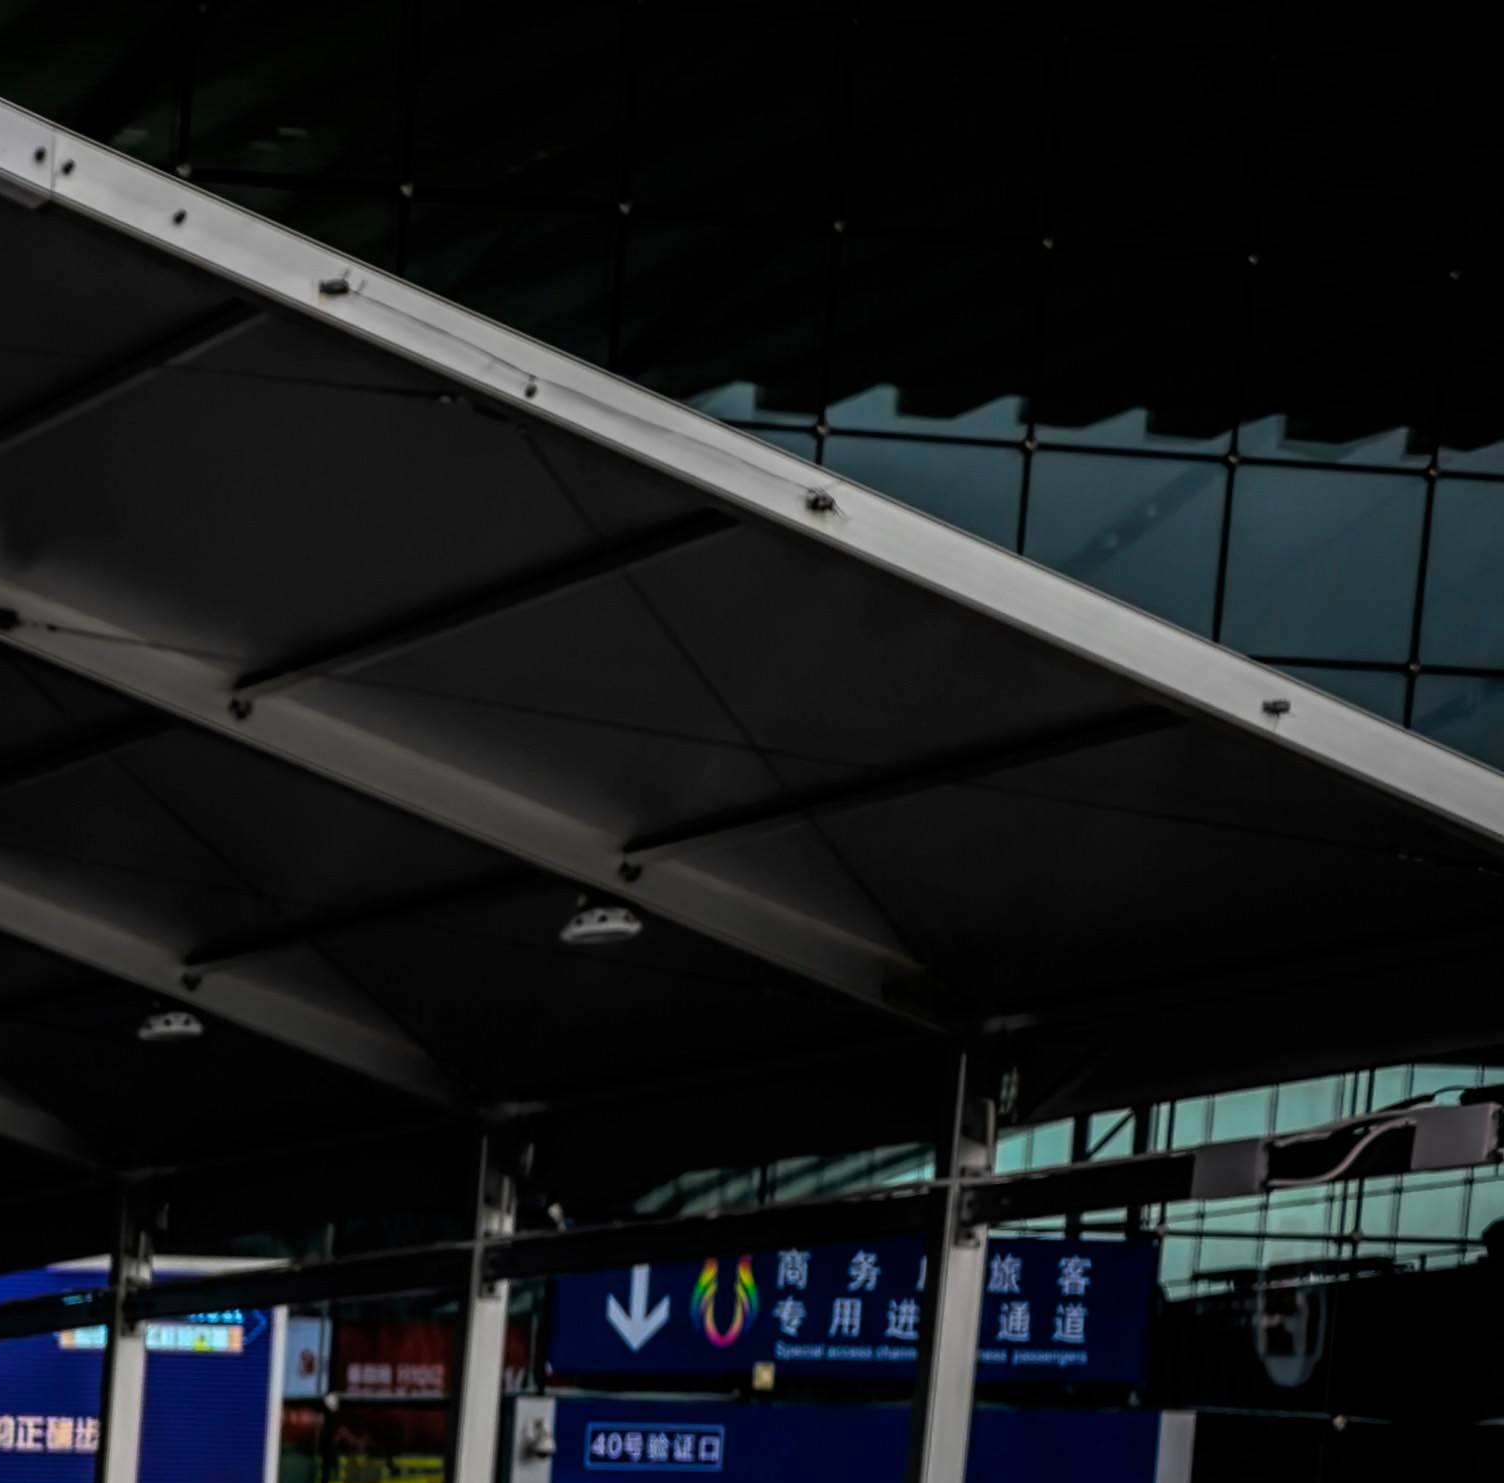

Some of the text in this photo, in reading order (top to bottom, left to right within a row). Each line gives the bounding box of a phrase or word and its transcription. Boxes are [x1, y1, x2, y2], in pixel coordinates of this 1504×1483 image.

[775, 1247, 1092, 1297] 商务旅客
[772, 1295, 1089, 1344] 专用进通道
[590, 1430, 722, 1465] 40号验证口
